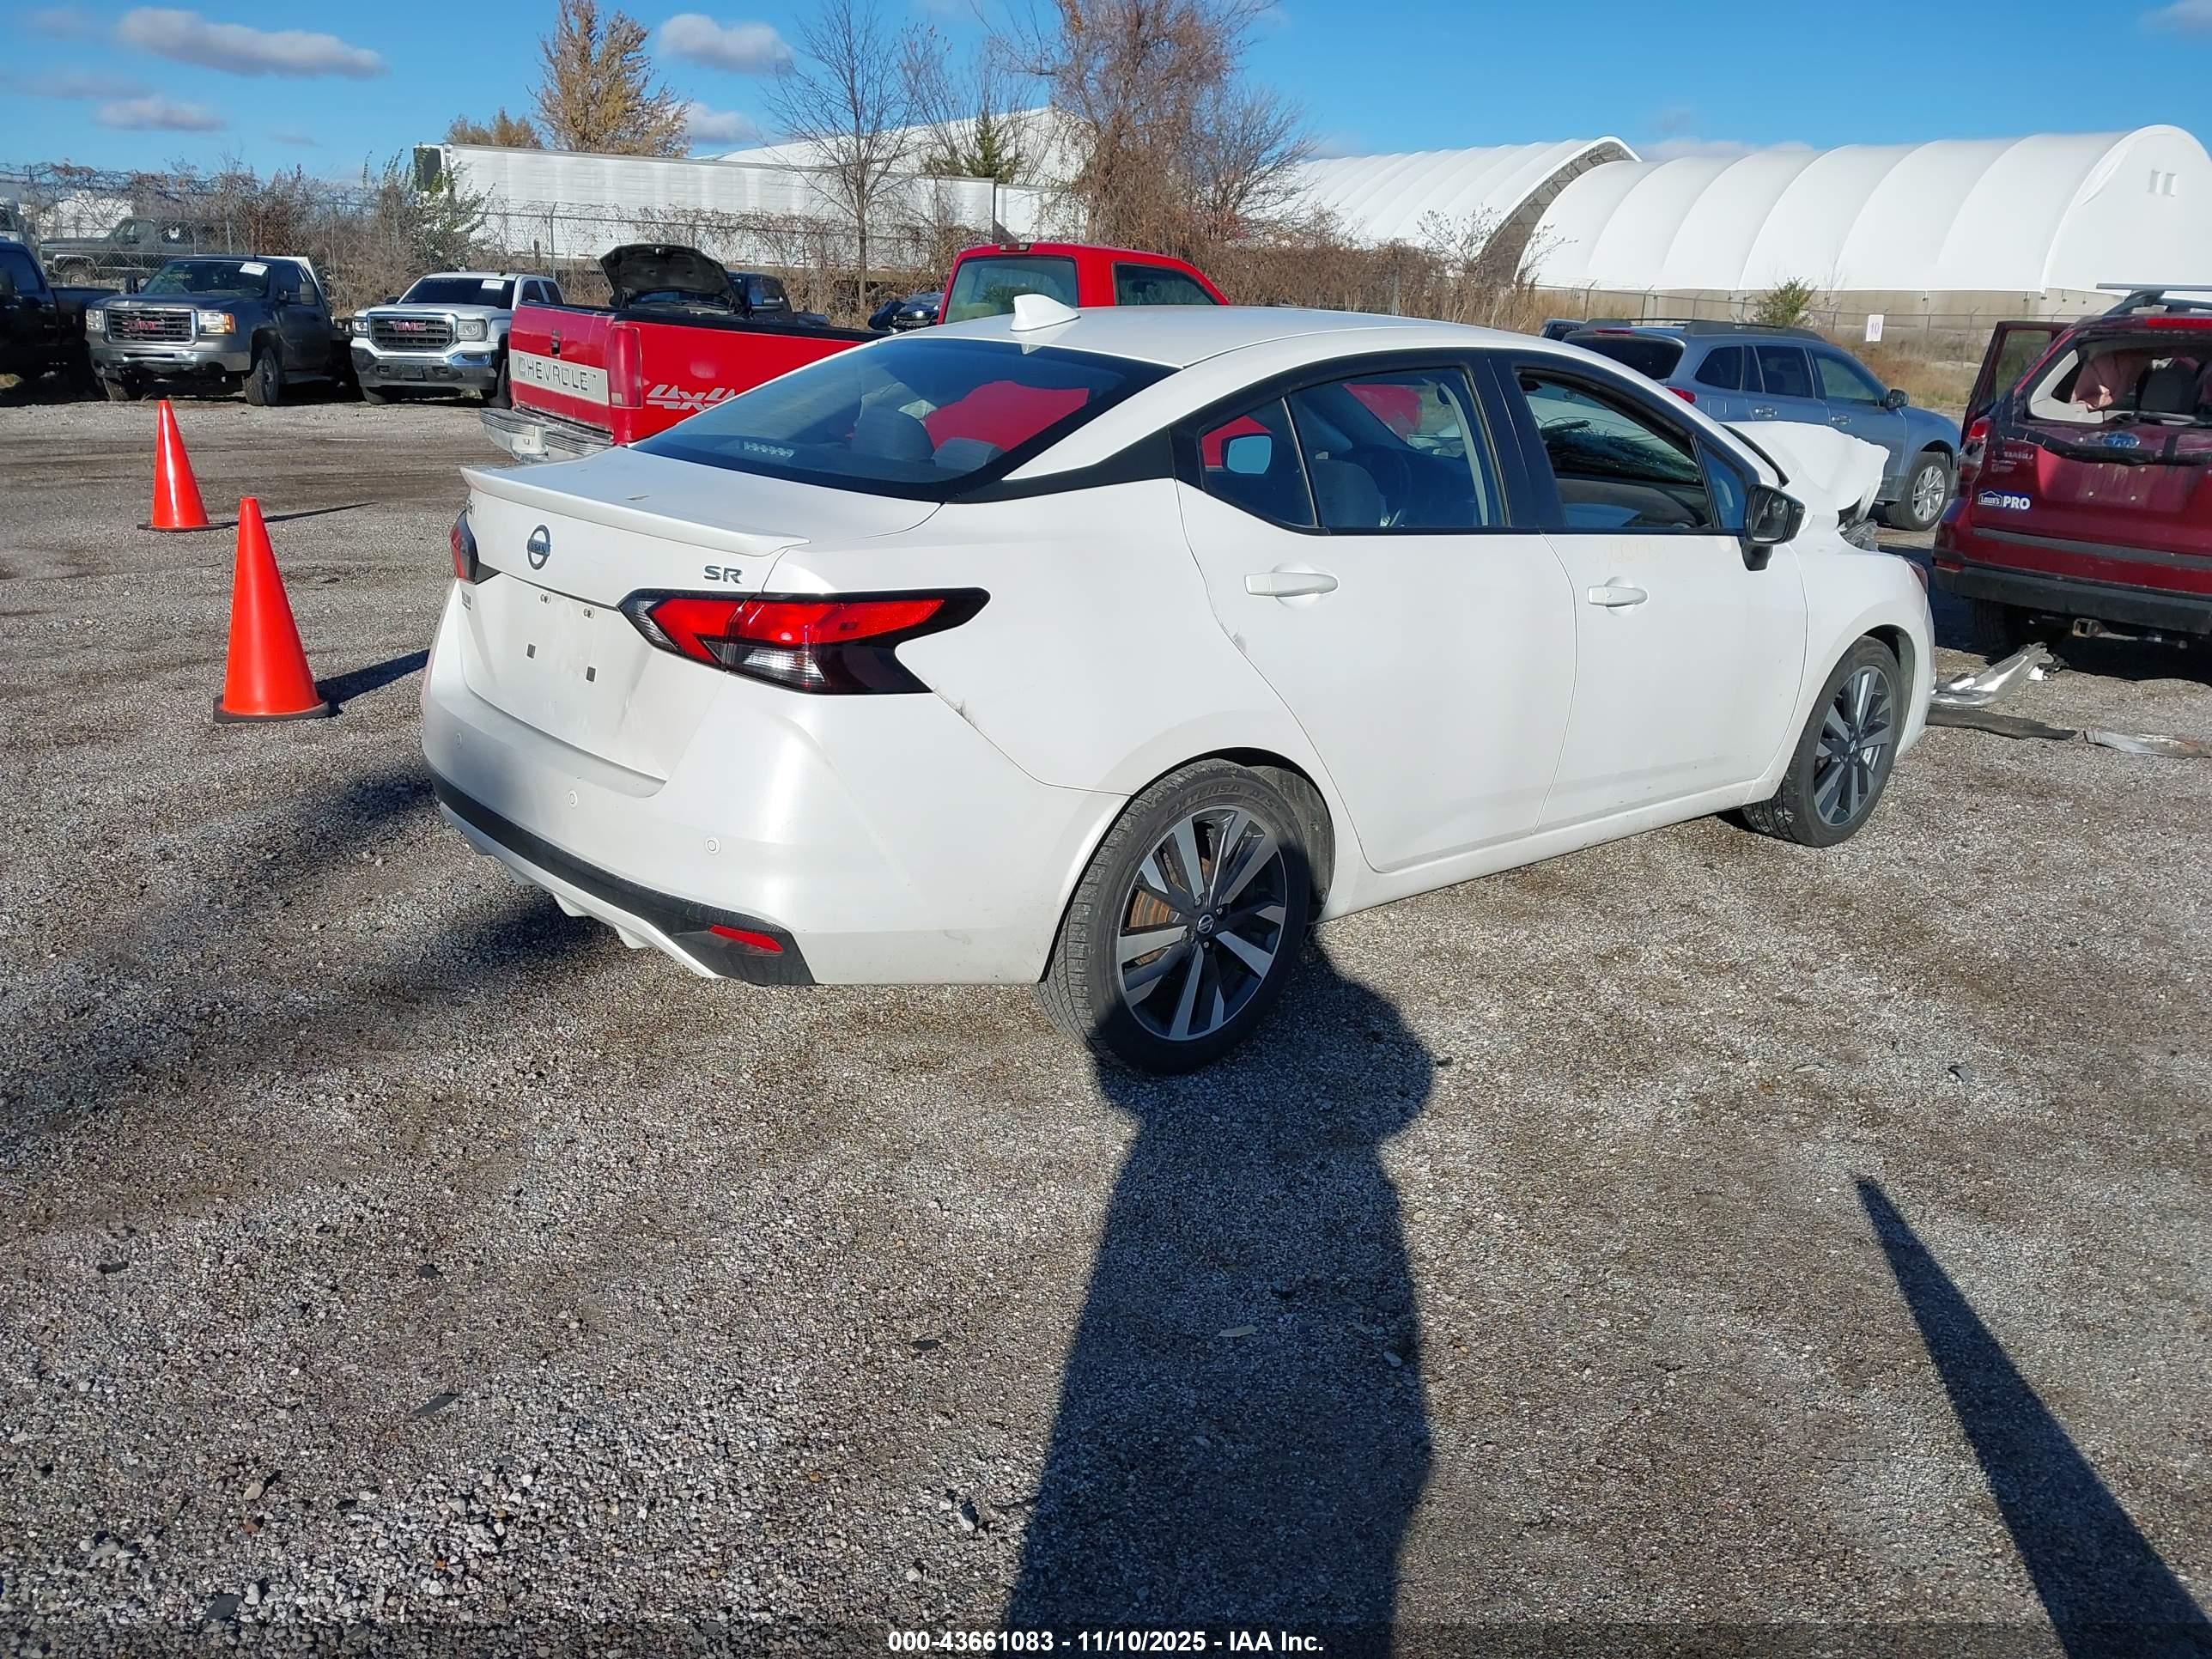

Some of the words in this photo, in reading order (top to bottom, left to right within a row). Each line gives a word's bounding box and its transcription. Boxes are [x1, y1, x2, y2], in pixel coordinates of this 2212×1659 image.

[392, 320, 428, 331] GMC
[518, 356, 598, 394] CHEVROLET
[2002, 495, 2031, 510] PRO
[704, 565, 743, 585] SR
